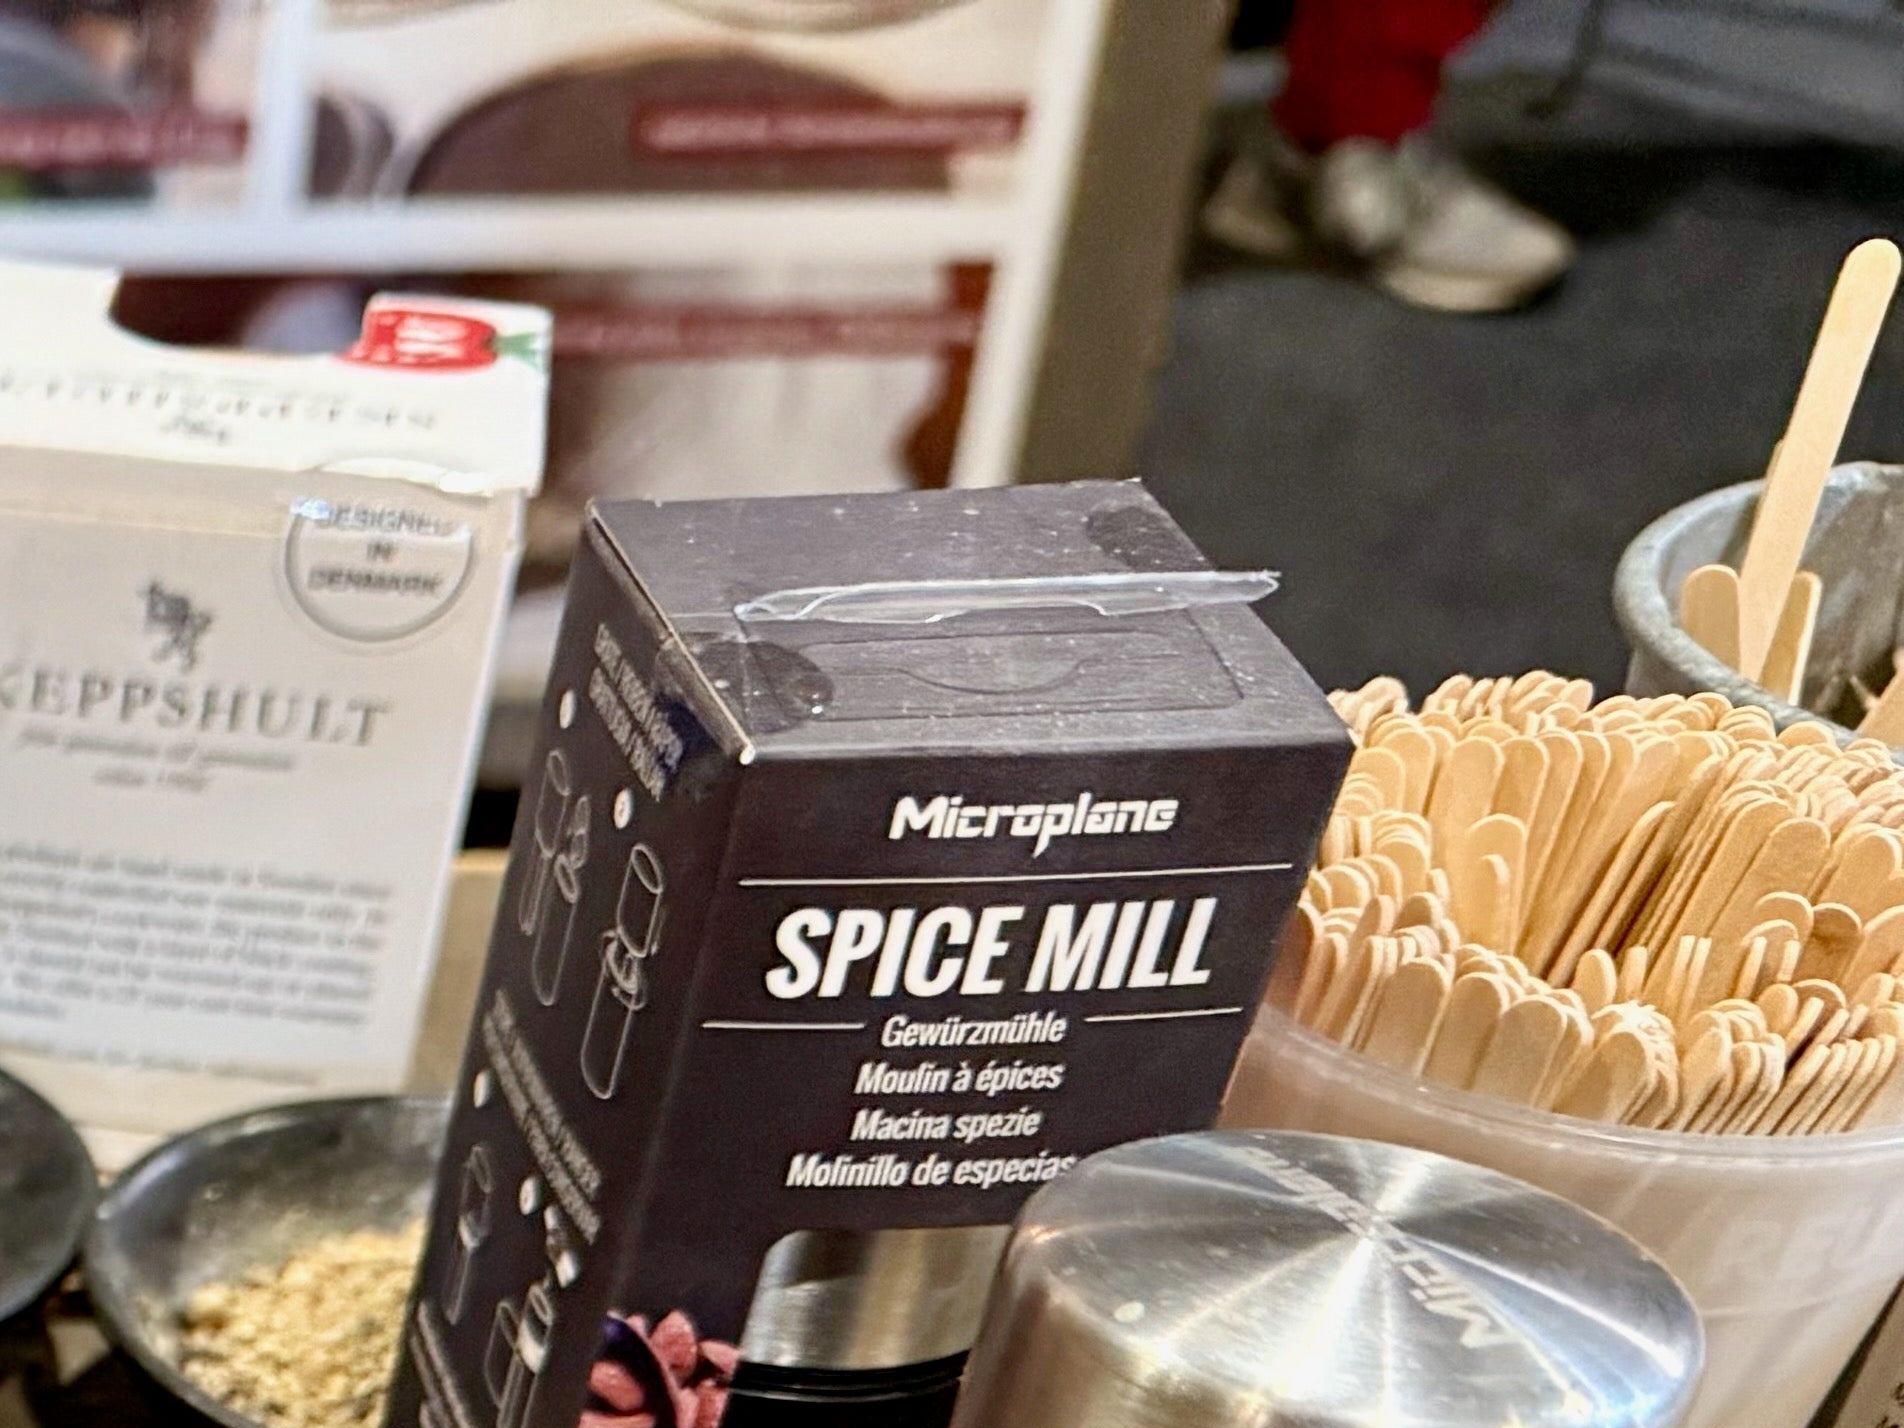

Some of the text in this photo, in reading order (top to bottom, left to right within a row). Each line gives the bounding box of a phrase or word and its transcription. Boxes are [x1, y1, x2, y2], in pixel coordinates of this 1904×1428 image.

[889, 791, 1180, 858] Microplane
[765, 896, 1218, 1000] SPICE MILL
[881, 1013, 1069, 1049] Gewürzmühle
[854, 1058, 1065, 1101] Moulin à épices
[851, 1104, 1041, 1146] Macina spezie
[786, 1153, 907, 1188] Molinillo
[912, 1154, 948, 1186] de
